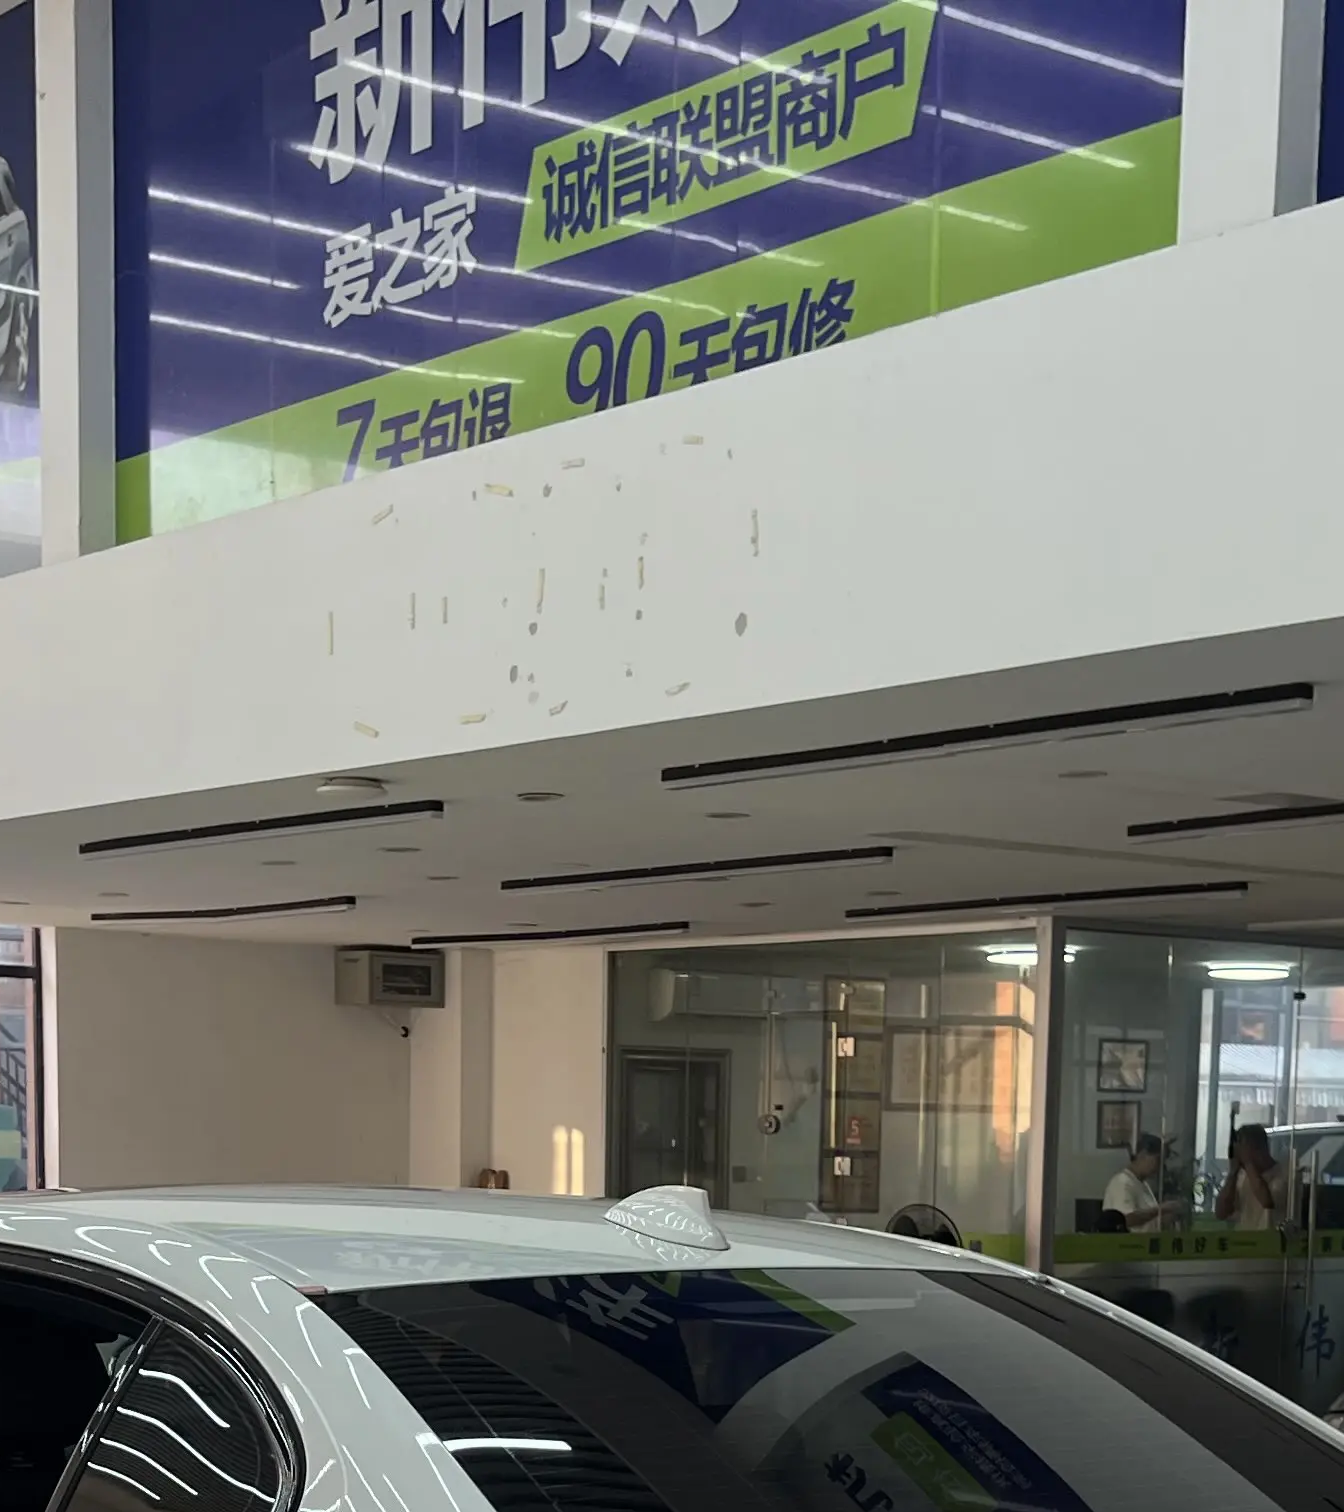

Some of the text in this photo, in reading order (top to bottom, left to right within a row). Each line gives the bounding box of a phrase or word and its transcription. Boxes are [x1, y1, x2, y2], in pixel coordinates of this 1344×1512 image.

[323, 23, 906, 329] 爱之家 诚信联盟商户
